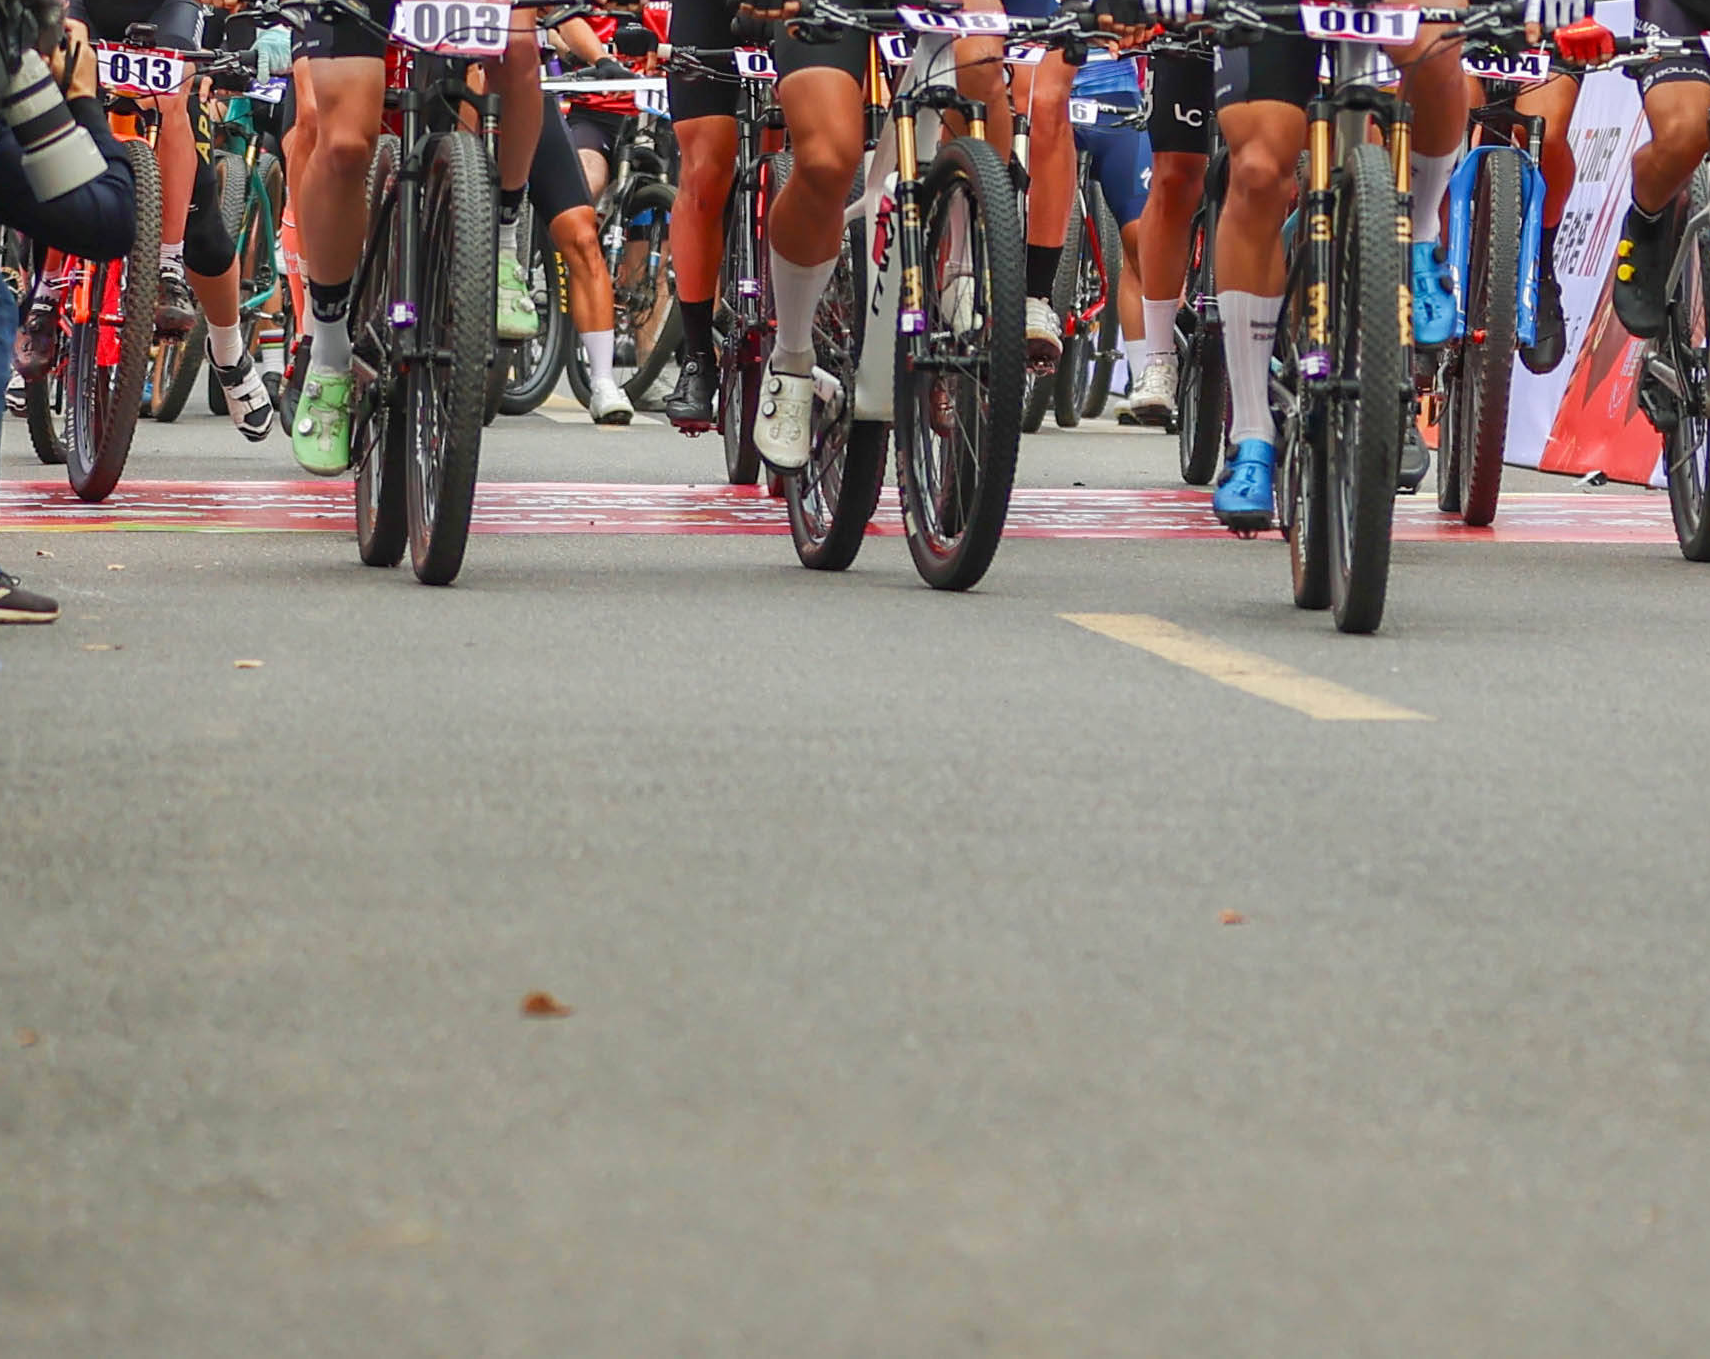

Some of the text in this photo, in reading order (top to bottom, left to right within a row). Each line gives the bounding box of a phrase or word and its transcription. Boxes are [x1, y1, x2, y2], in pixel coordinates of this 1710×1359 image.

[413, 3, 501, 46] 003
[1319, 10, 1405, 37] 001
[109, 52, 173, 90] 013
